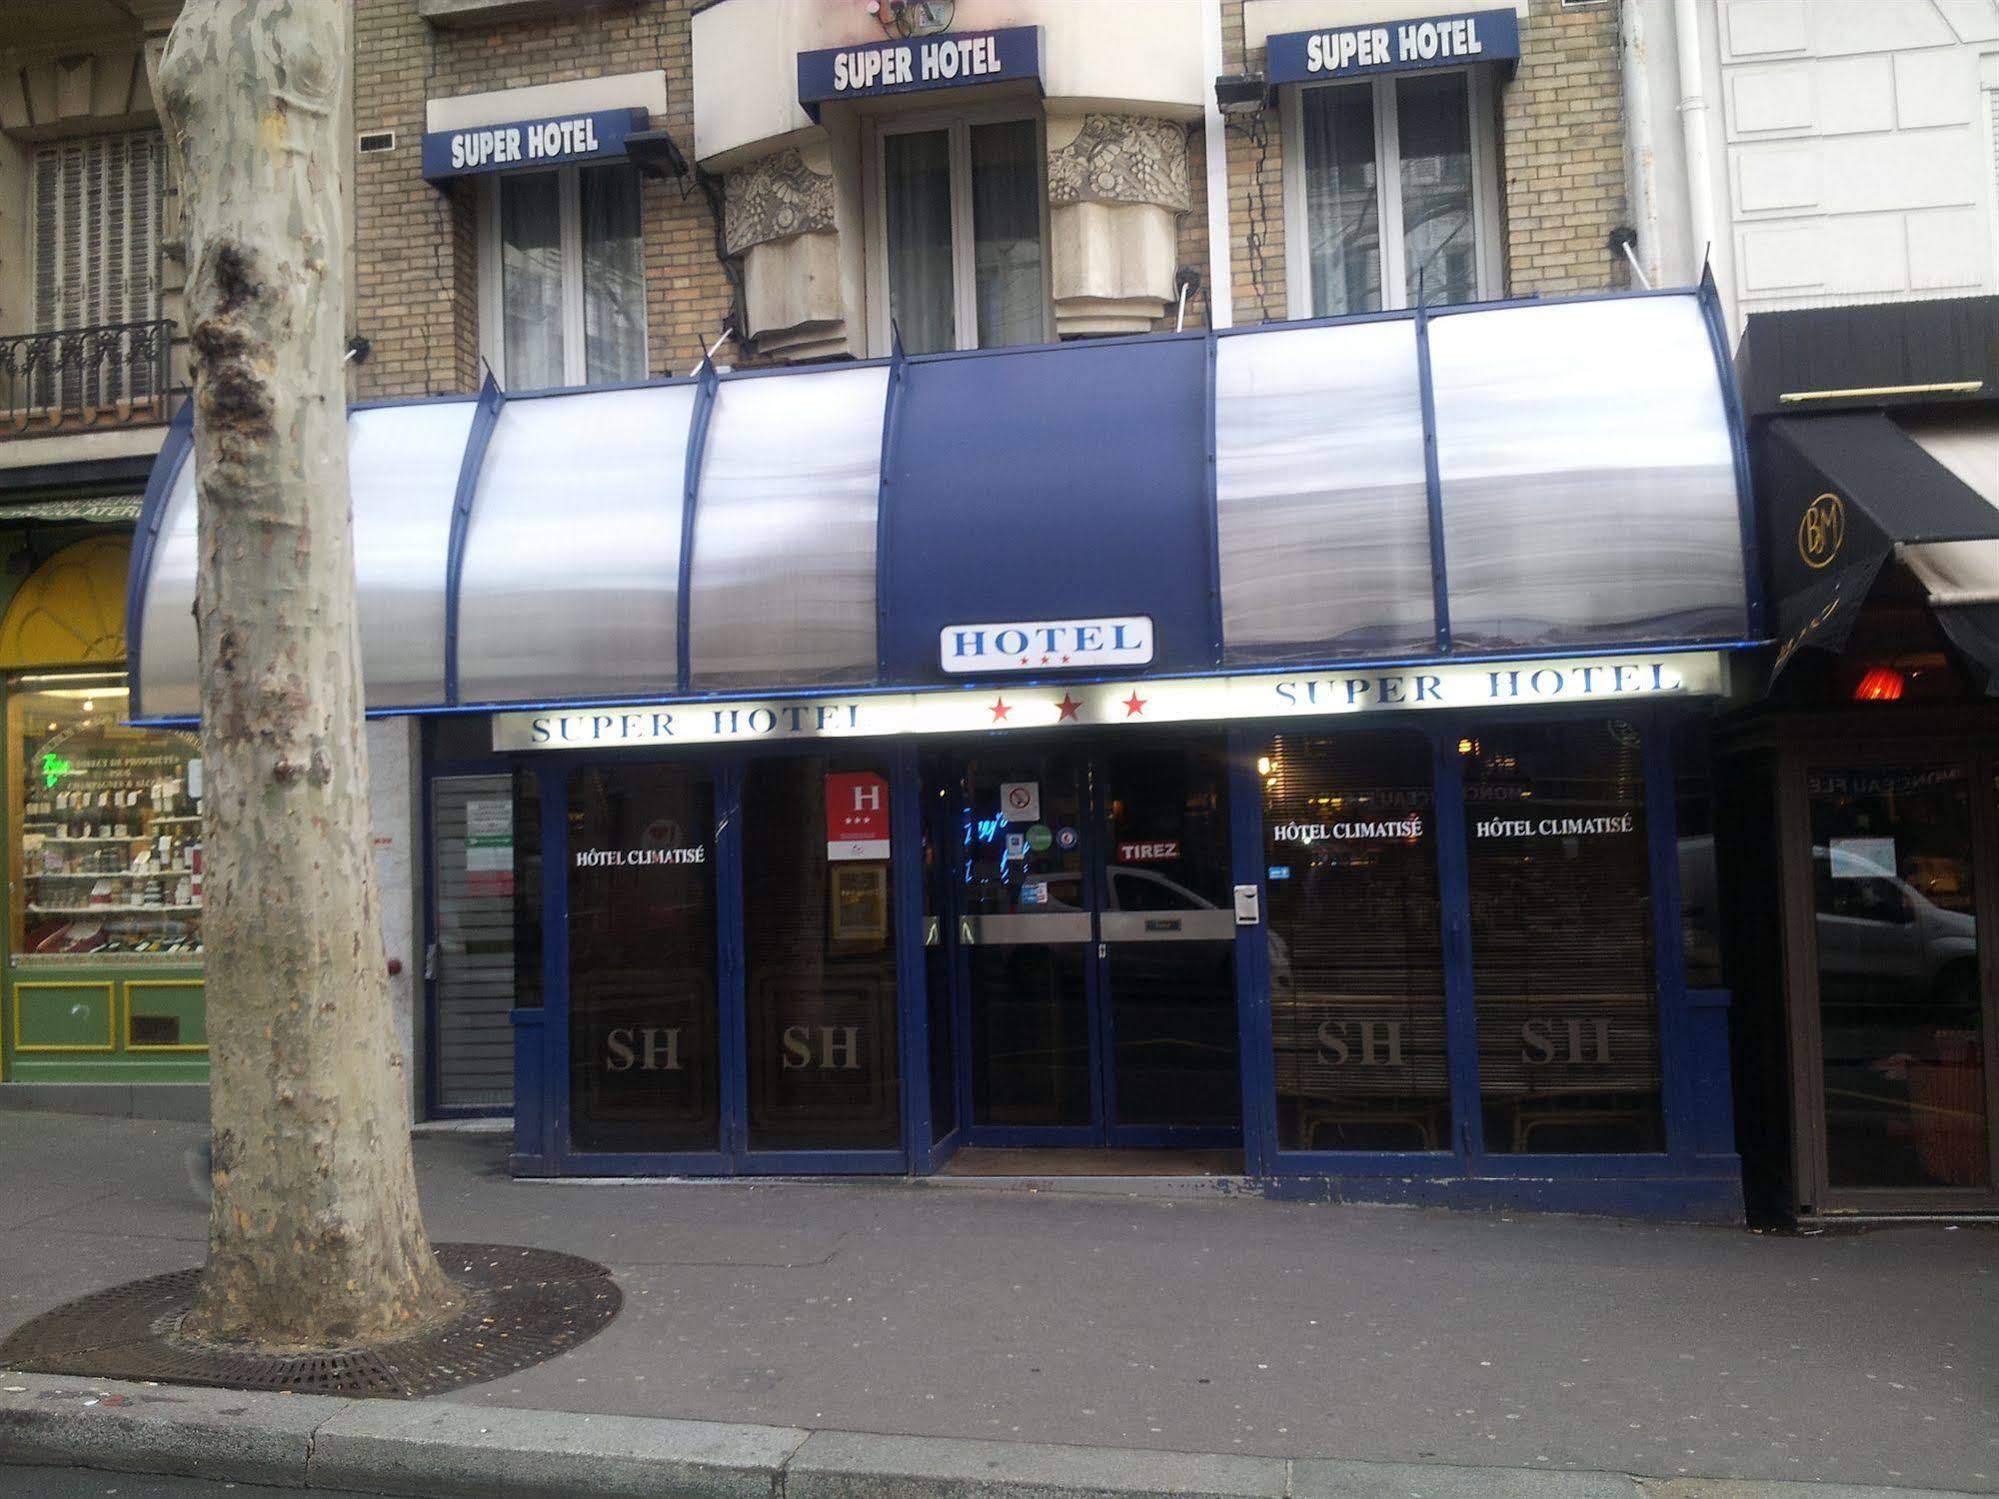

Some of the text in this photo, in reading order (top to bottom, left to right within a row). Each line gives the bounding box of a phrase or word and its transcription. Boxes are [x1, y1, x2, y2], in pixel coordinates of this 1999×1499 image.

[833, 36, 1002, 91] SUPER HOTEL
[1306, 18, 1483, 73] SUPER HOTEL
[451, 118, 599, 169] SUPER HOTEL
[952, 624, 1143, 657] HOTEL
[1276, 663, 1682, 706] SUPER HOTEL
[531, 704, 865, 744] SUPER HOTEL
[854, 785, 880, 811] H
[1274, 817, 1423, 842] HÔTEL CLIMATISÉ
[1476, 812, 1633, 838] HÔTEL CLIMATISÉ
[576, 845, 705, 867] HÔTEL CLIMATISÉ
[1121, 843, 1178, 859] TIREZ
[606, 1026, 684, 1072] SH
[781, 1025, 863, 1071] SH
[1315, 1020, 1408, 1067] SH
[1521, 1017, 1617, 1066] SH
